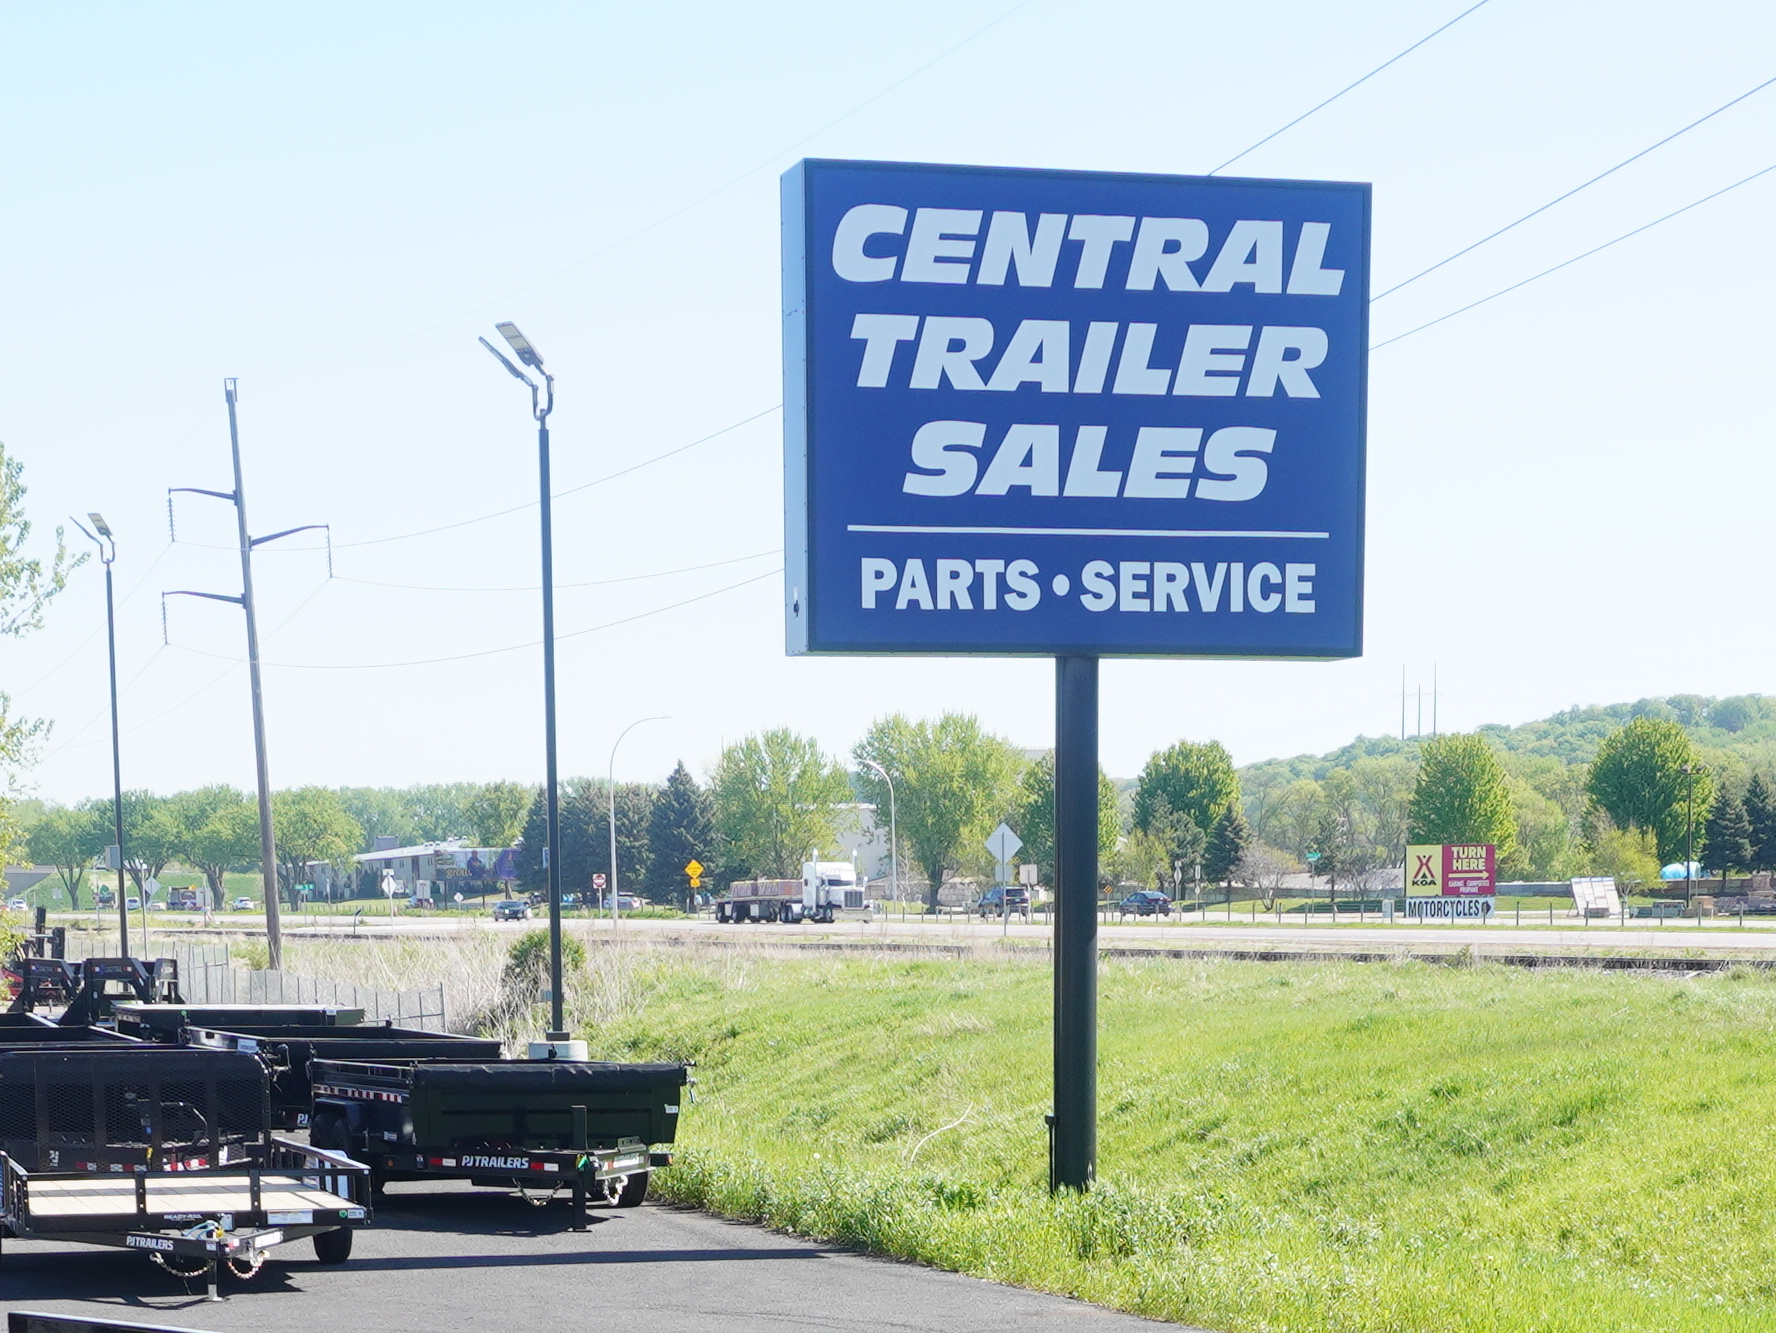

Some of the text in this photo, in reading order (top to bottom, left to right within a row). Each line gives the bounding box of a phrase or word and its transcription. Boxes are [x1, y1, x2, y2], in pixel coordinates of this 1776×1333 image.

[832, 203, 1346, 297] CENTRAL
[850, 313, 1329, 399] TRAILER
[903, 420, 1277, 502] SALES
[860, 557, 1317, 614] PARTS SERVICE
[1451, 846, 1486, 859] TURN
[1452, 858, 1486, 871] HERE
[1408, 899, 1480, 918] MOTORCYCLES
[461, 1155, 530, 1169] PJ TRAILERS
[134, 1236, 175, 1251] TRAILERS
